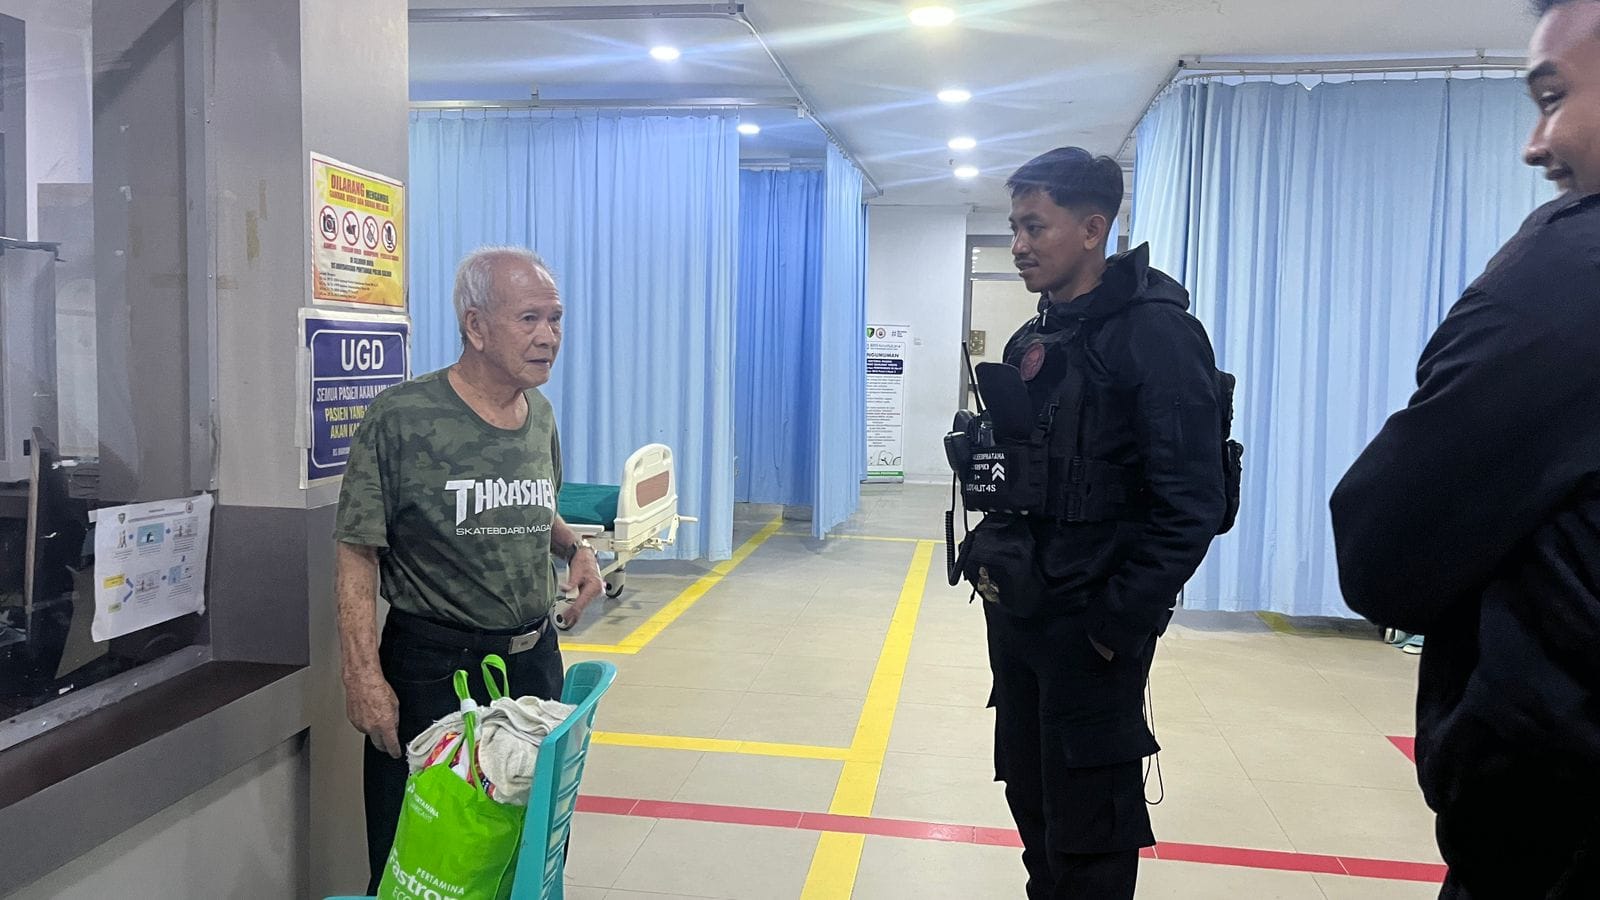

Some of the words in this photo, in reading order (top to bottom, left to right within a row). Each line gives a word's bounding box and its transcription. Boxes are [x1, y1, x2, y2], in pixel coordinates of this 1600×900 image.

[331, 174, 365, 197] DILARANG
[341, 339, 384, 371] UGD
[316, 386, 337, 402] SEMUA
[338, 386, 358, 400] PASIEN
[360, 385, 375, 399] AKAN
[325, 407, 348, 422] PASIEN
[349, 405, 365, 419] YANG
[330, 424, 348, 439] AKAN
[444, 477, 555, 527] THRASHE
[456, 526, 526, 536] SKATEBOARD
[416, 867, 465, 895] PERTAMINA
